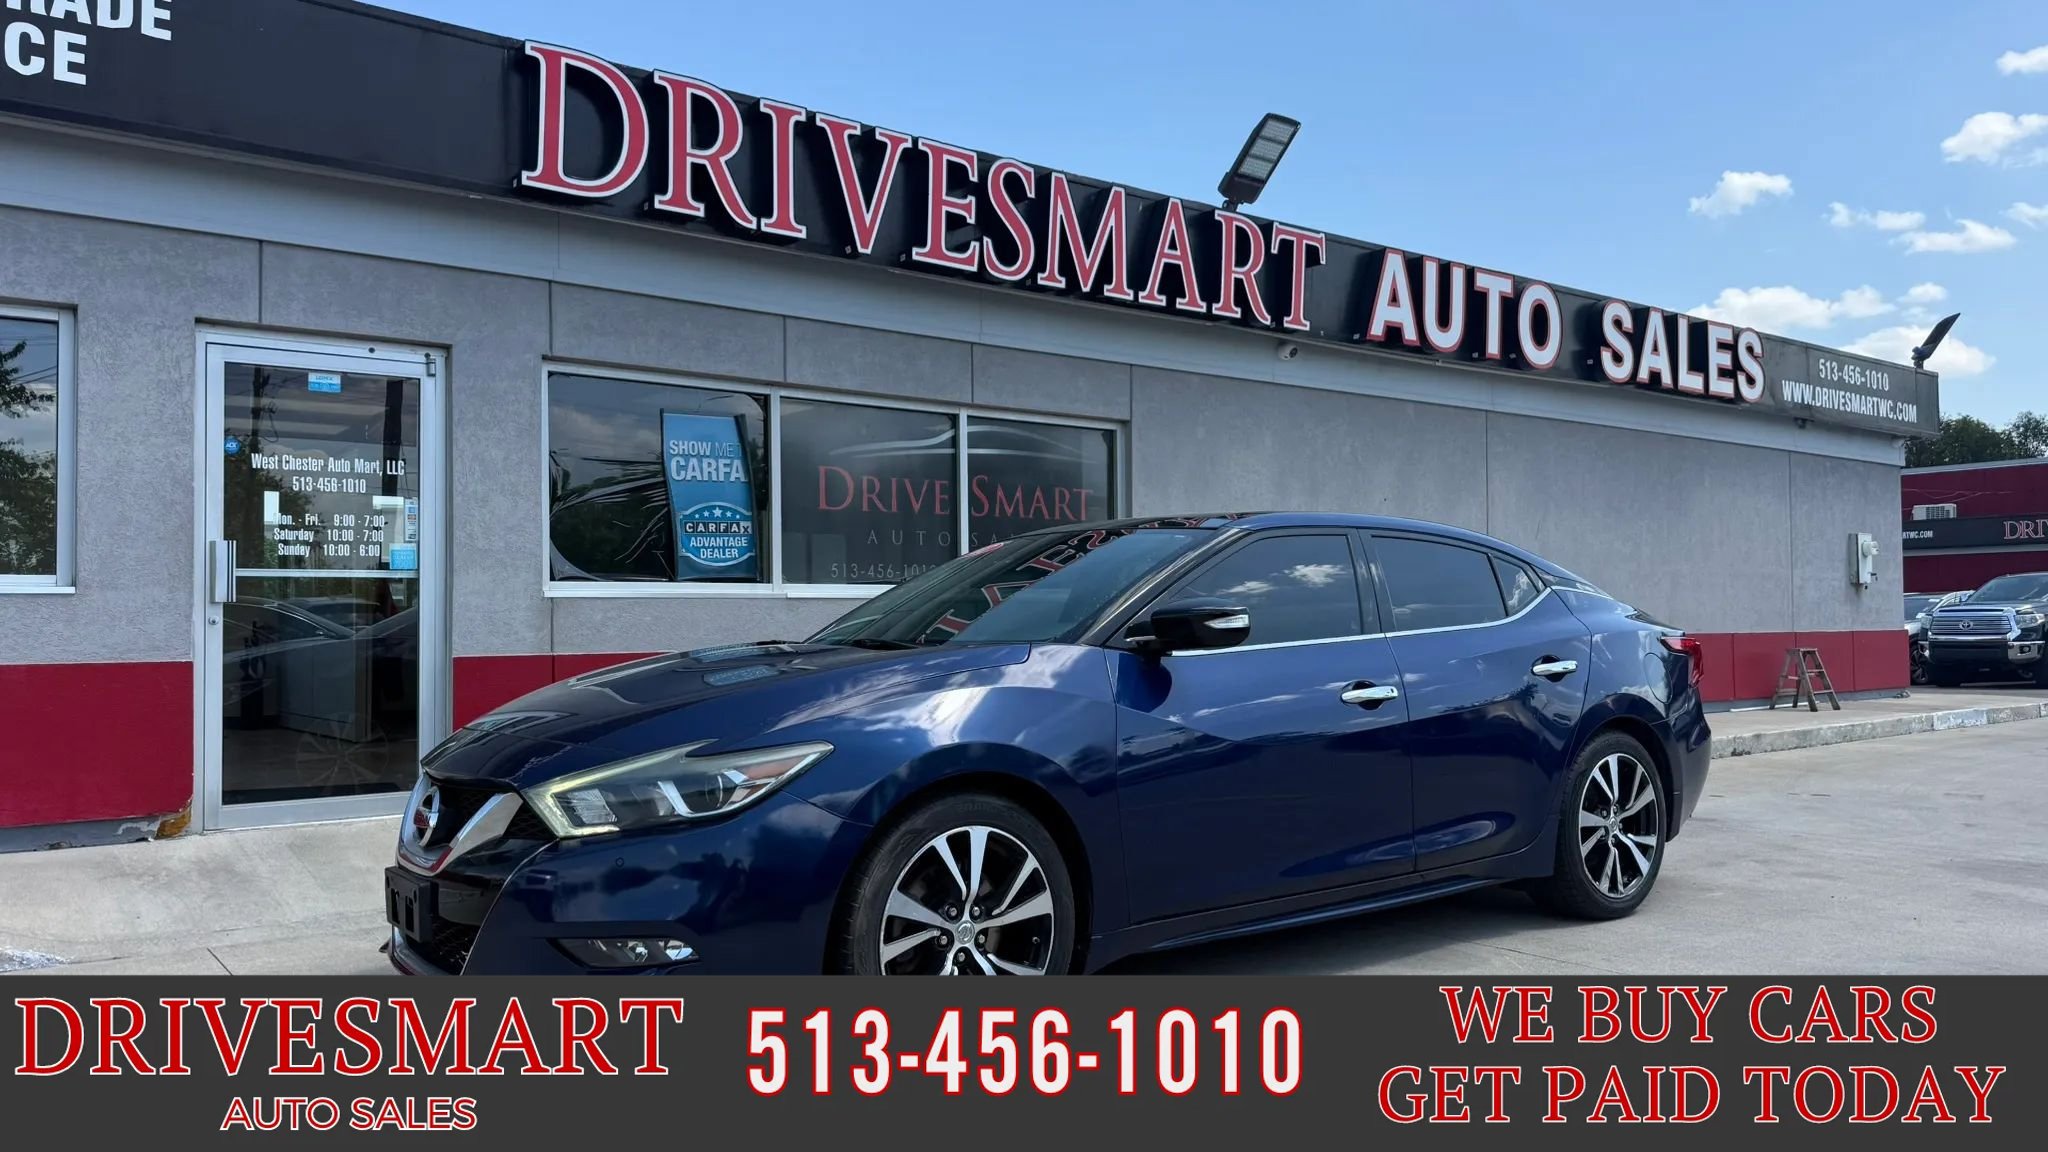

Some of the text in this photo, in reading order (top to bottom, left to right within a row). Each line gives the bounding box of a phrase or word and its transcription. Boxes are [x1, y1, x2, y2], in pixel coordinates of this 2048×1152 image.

[521, 39, 1766, 403] DRIVESMART AUTO SALES
[1818, 358, 1889, 392] 513-456-1010
[1782, 379, 1917, 424] WWW.DRIVESMARTWC.COM
[669, 439, 712, 456] SHOW
[715, 441, 735, 457] ME
[251, 453, 405, 476] West Chester Auto Mart, LLC
[292, 476, 367, 493] 513-456-1010
[816, 465, 1094, 521] DRIVE SMART
[305, 513, 321, 526] Fri.
[333, 513, 355, 527] 9:00
[363, 514, 385, 527] 7:00
[684, 521, 752, 534] CARFAX
[273, 528, 315, 542] Saturday
[327, 528, 354, 542] 10:00
[362, 529, 384, 542] 7:00
[689, 536, 749, 547] ADVANTAGE
[867, 529, 951, 546] AUTO
[278, 543, 310, 557] Sunday
[323, 543, 350, 556] 10:00
[359, 544, 380, 557] 6:00
[700, 548, 739, 559] DEALER
